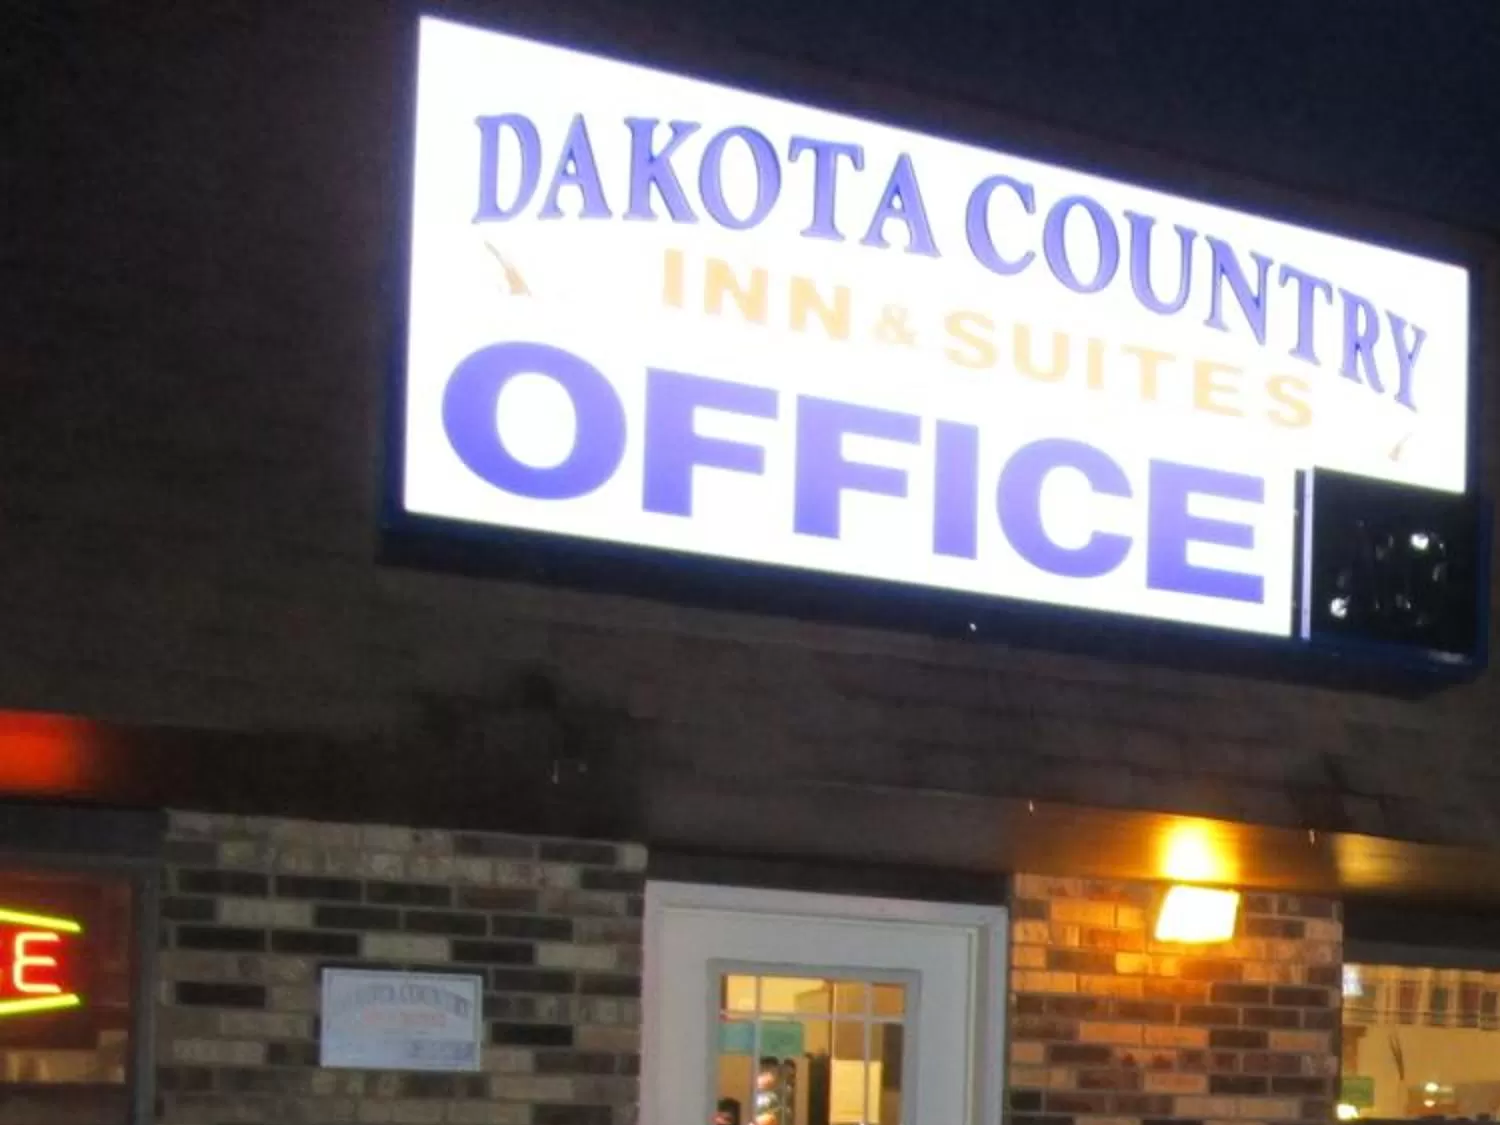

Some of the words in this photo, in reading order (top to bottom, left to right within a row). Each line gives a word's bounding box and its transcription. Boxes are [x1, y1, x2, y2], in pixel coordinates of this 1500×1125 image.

[473, 112, 938, 258] DAKOTA
[964, 173, 1426, 410] COUNTRY
[660, 244, 854, 343] INN
[942, 307, 1314, 430] SUITES
[440, 340, 1265, 605] OFFICE
